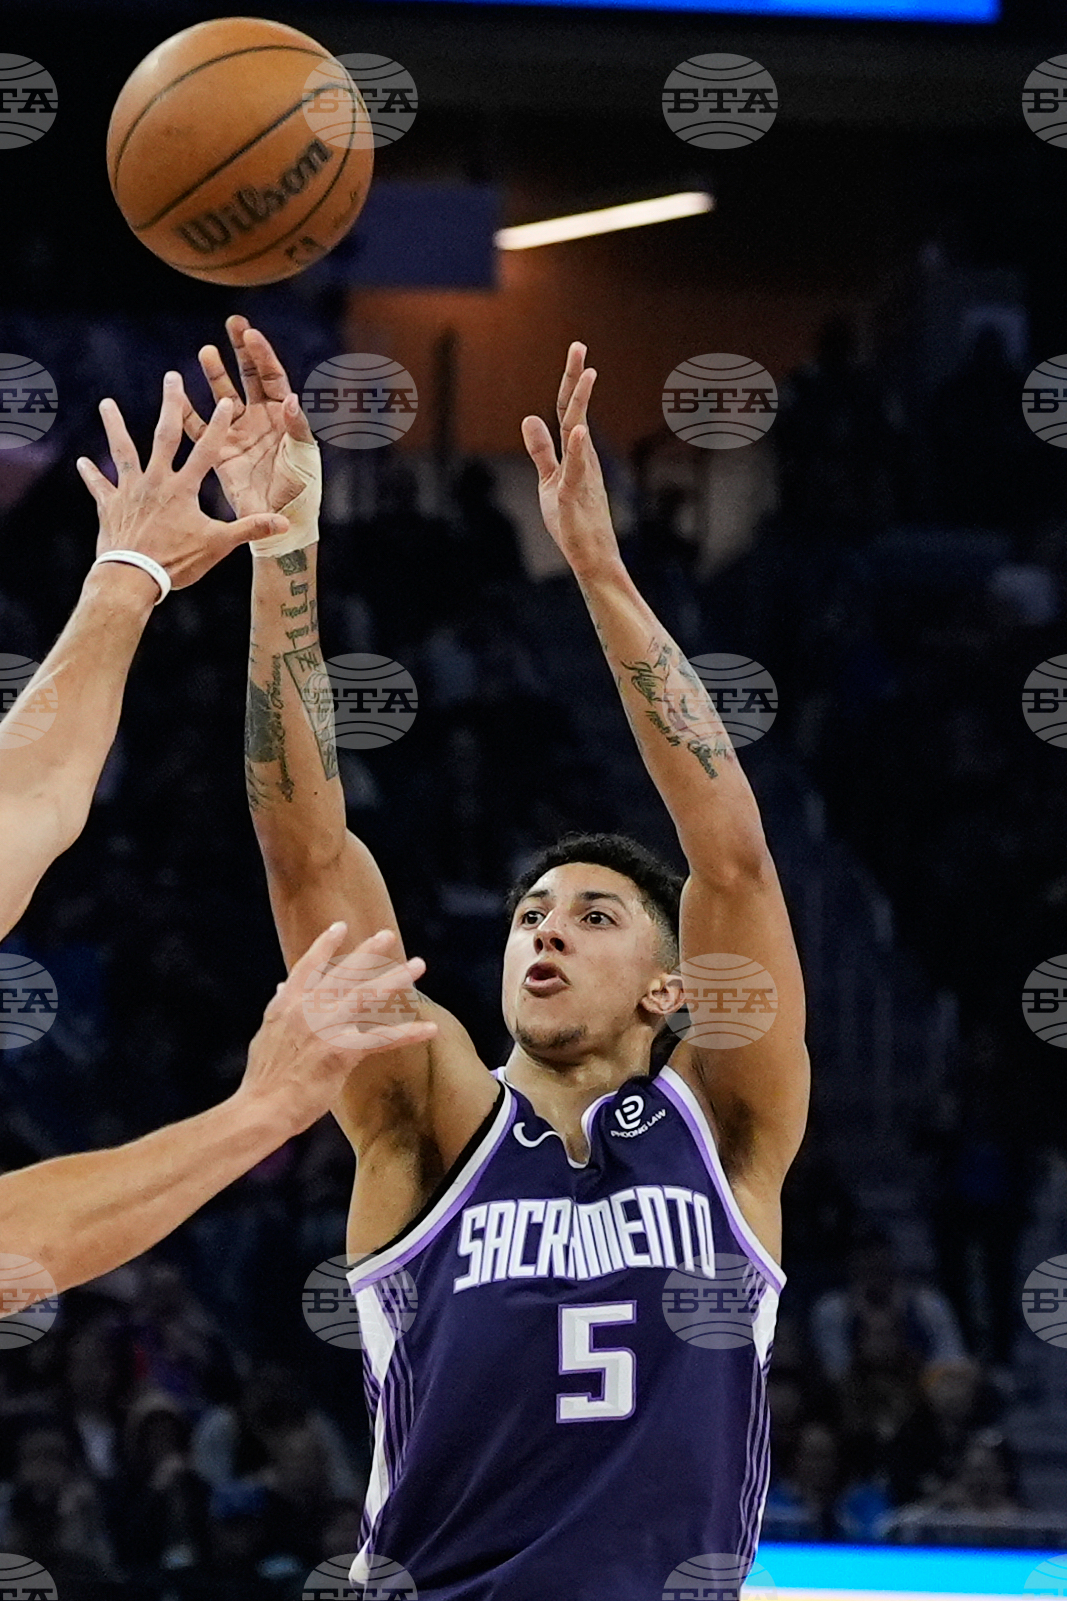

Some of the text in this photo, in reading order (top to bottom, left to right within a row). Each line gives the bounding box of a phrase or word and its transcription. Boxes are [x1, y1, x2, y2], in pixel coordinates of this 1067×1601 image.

[173, 138, 333, 254] Wilson
[646, 1108, 666, 1127] LAW
[453, 1184, 716, 1294] SACRAMENTO
[556, 1300, 638, 1424] 5
